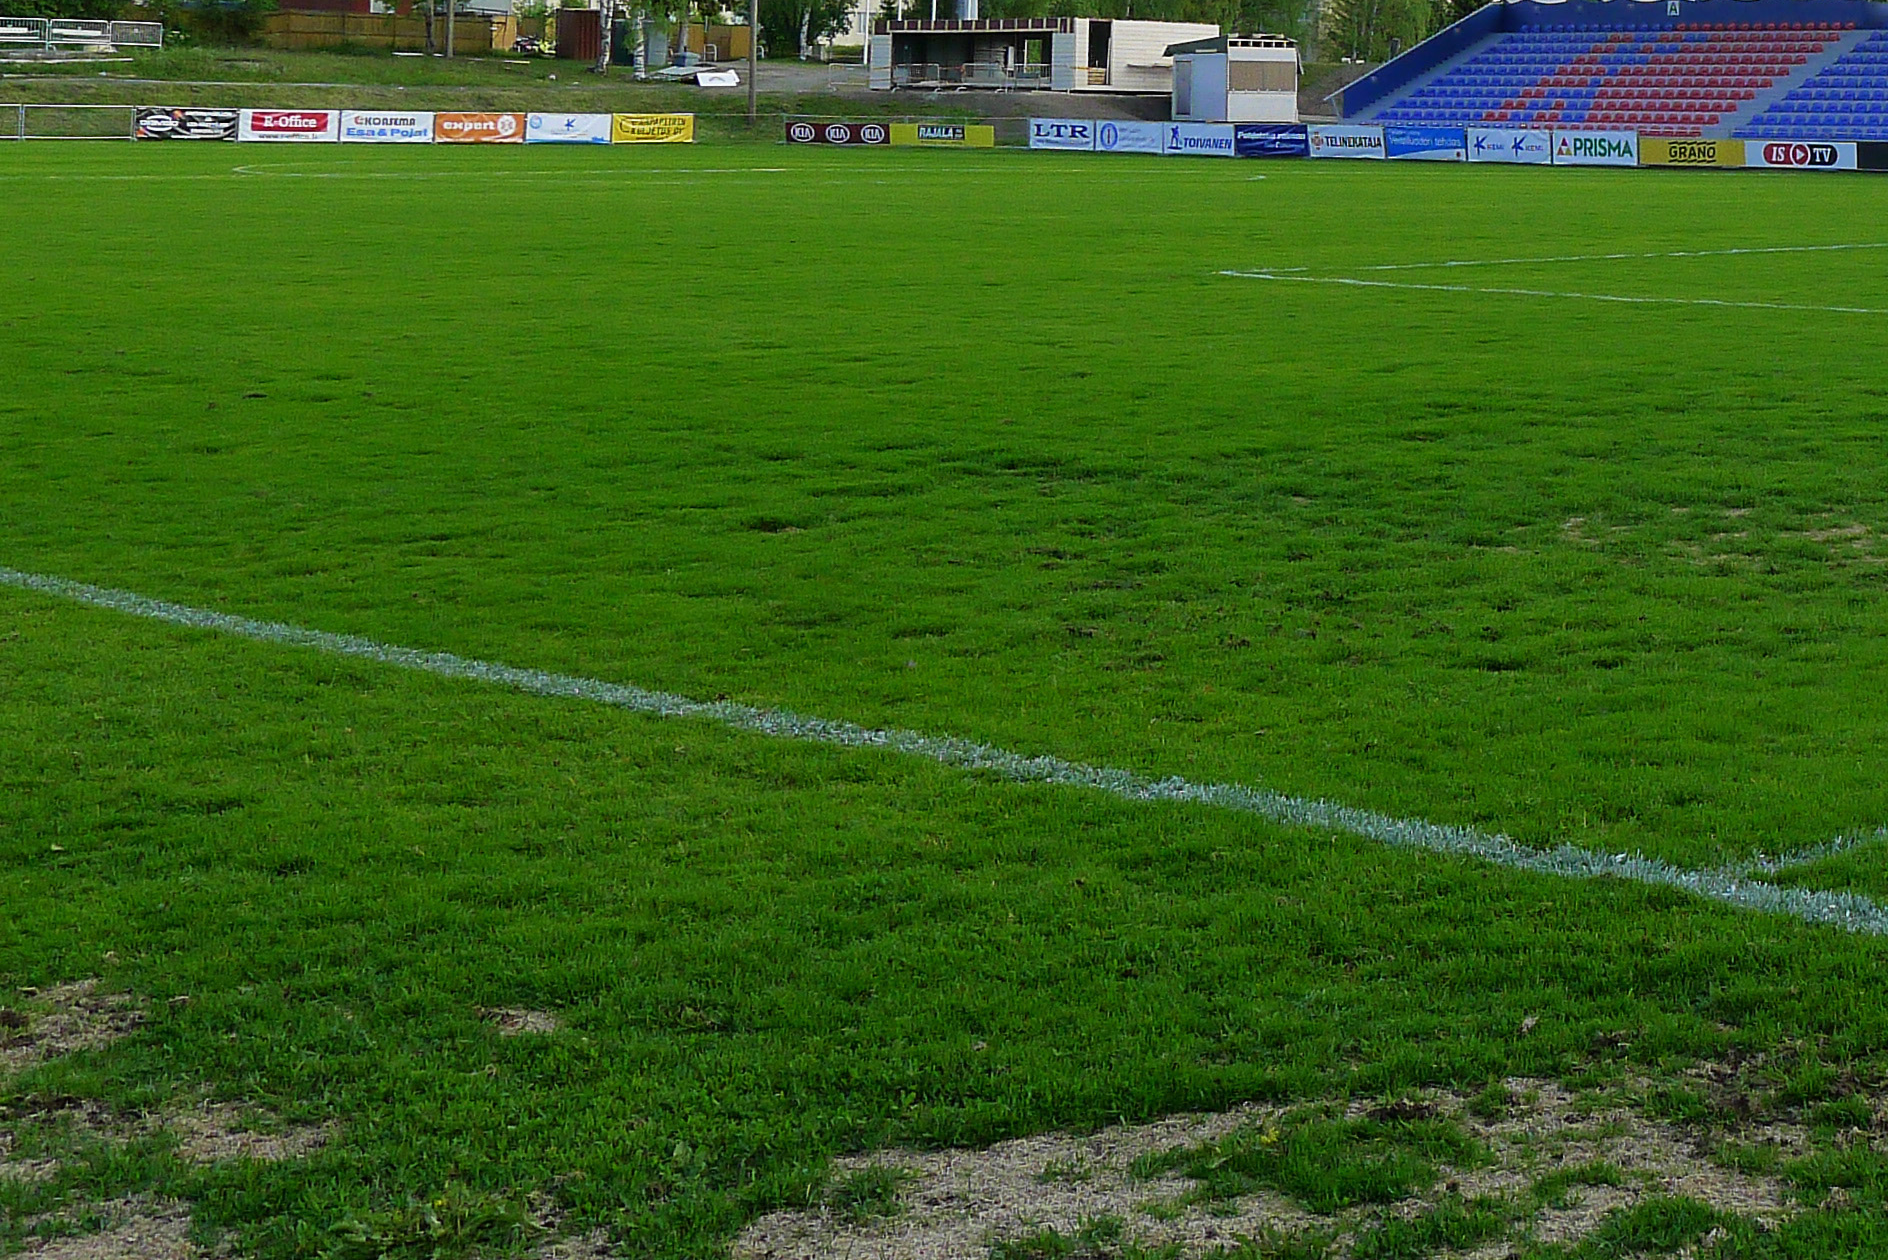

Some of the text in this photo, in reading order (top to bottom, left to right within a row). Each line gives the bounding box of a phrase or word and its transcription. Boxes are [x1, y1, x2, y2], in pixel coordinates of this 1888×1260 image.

[263, 115, 317, 128] R-Office
[442, 120, 496, 132] expert
[346, 127, 428, 138] Esa & Pojat
[919, 127, 954, 138] RAJALA
[1034, 123, 1090, 139] LTR
[1183, 137, 1233, 150] TOIVANEN
[1324, 135, 1382, 149] TELINEKATAJA
[1573, 137, 1633, 158] PRISMA
[1668, 144, 1716, 159] GRANO
[1771, 146, 1832, 163] IS TV
